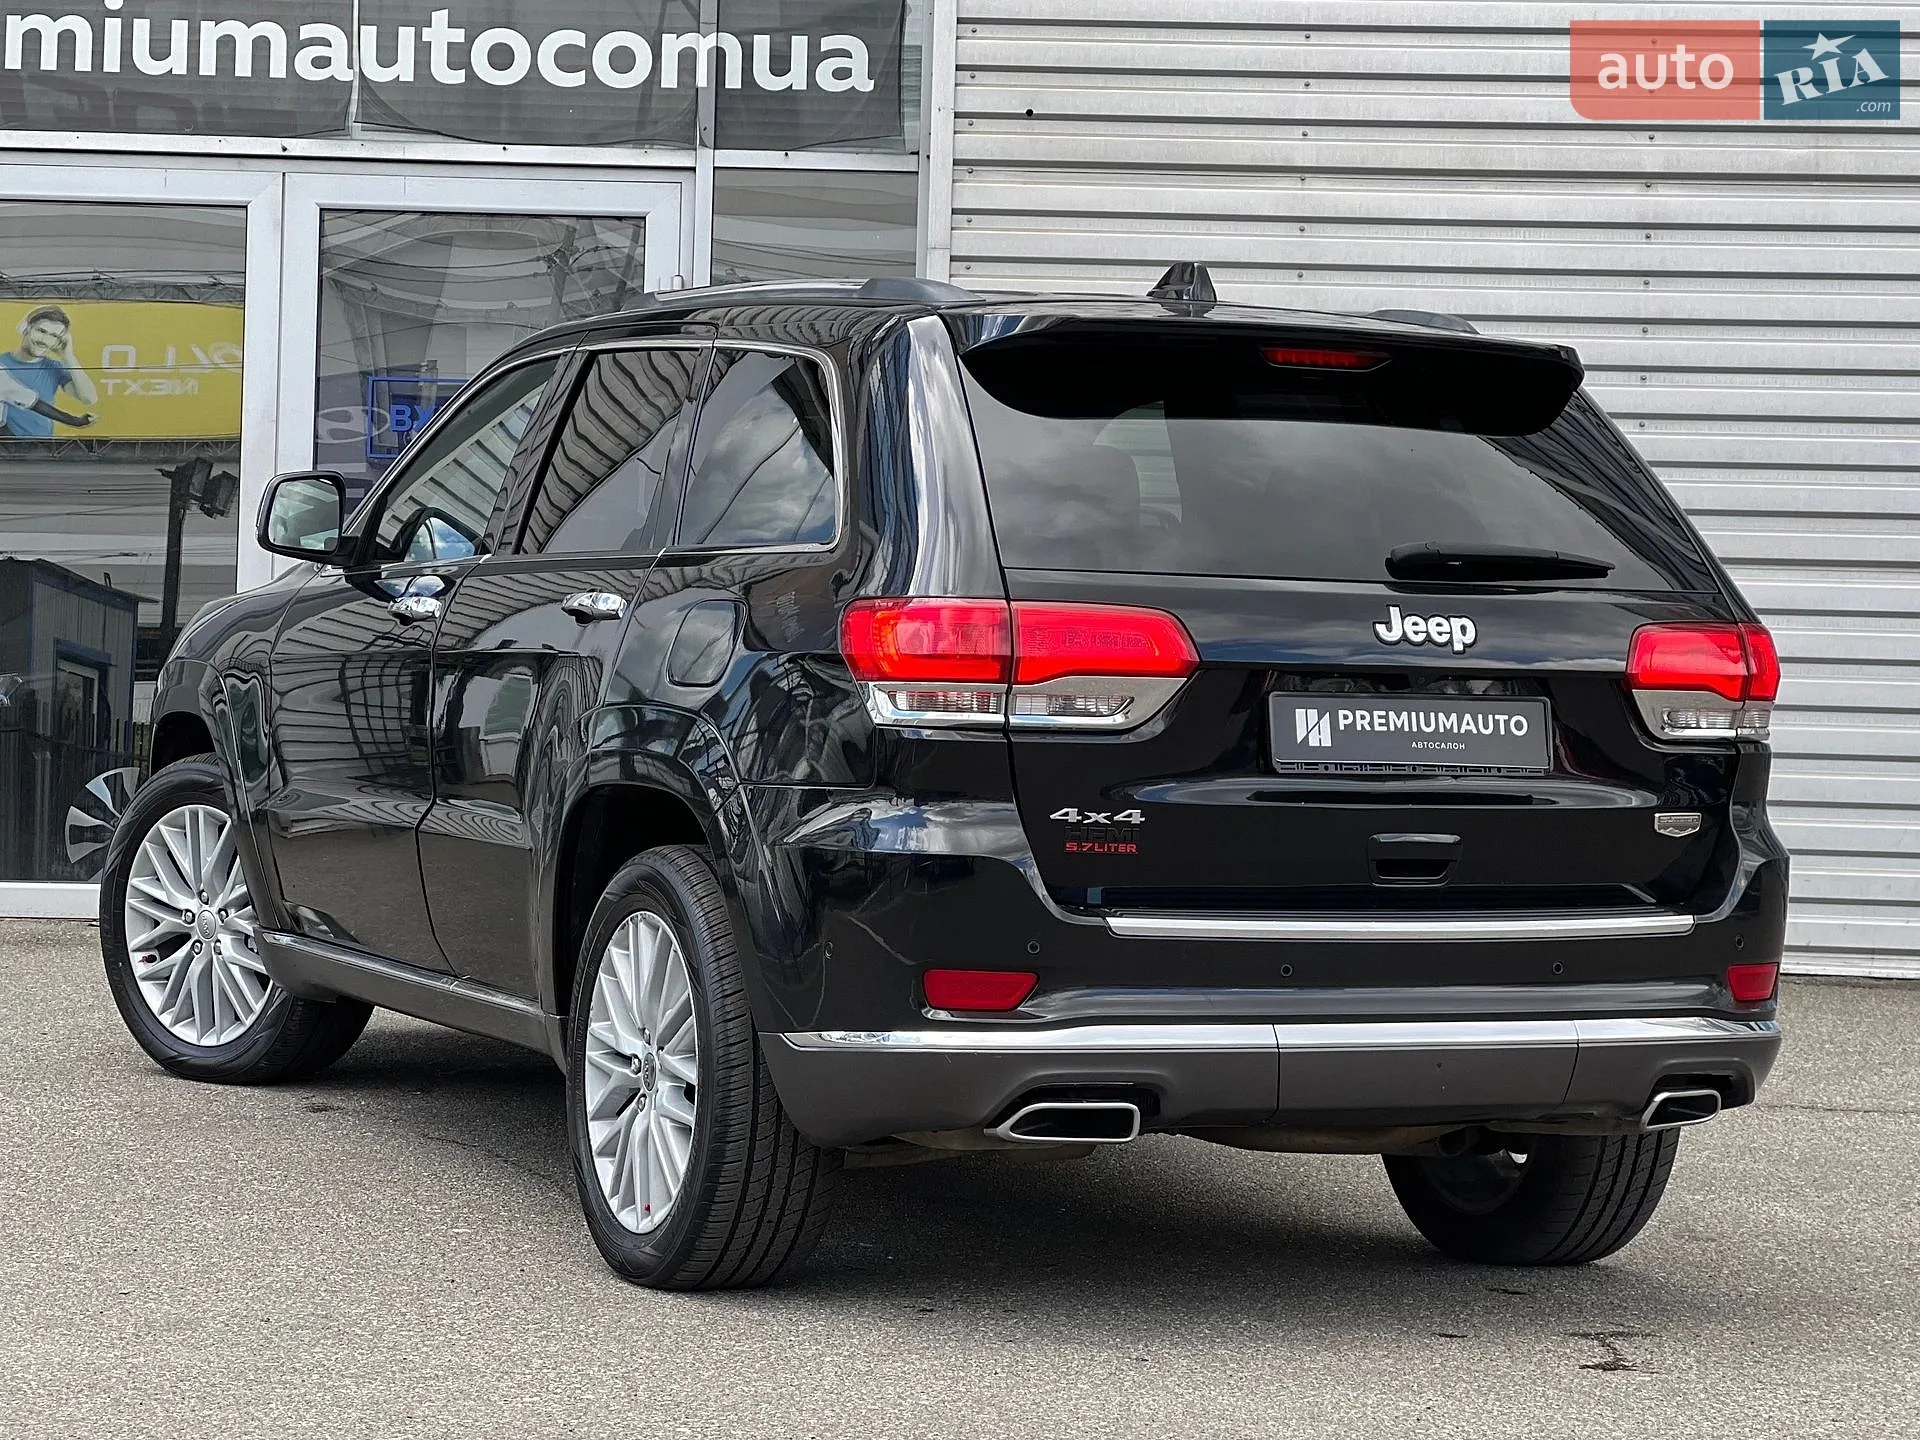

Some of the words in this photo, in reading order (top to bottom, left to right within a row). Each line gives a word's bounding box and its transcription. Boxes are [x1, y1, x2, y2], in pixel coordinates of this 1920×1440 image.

[4, 0, 875, 92] miumautocomua
[1374, 605, 1477, 652] Jeep
[1337, 708, 1529, 737] PREMIUMAUTO
[1411, 740, 1466, 750] АВТОСАЛОН
[1049, 807, 1146, 825] 4x4
